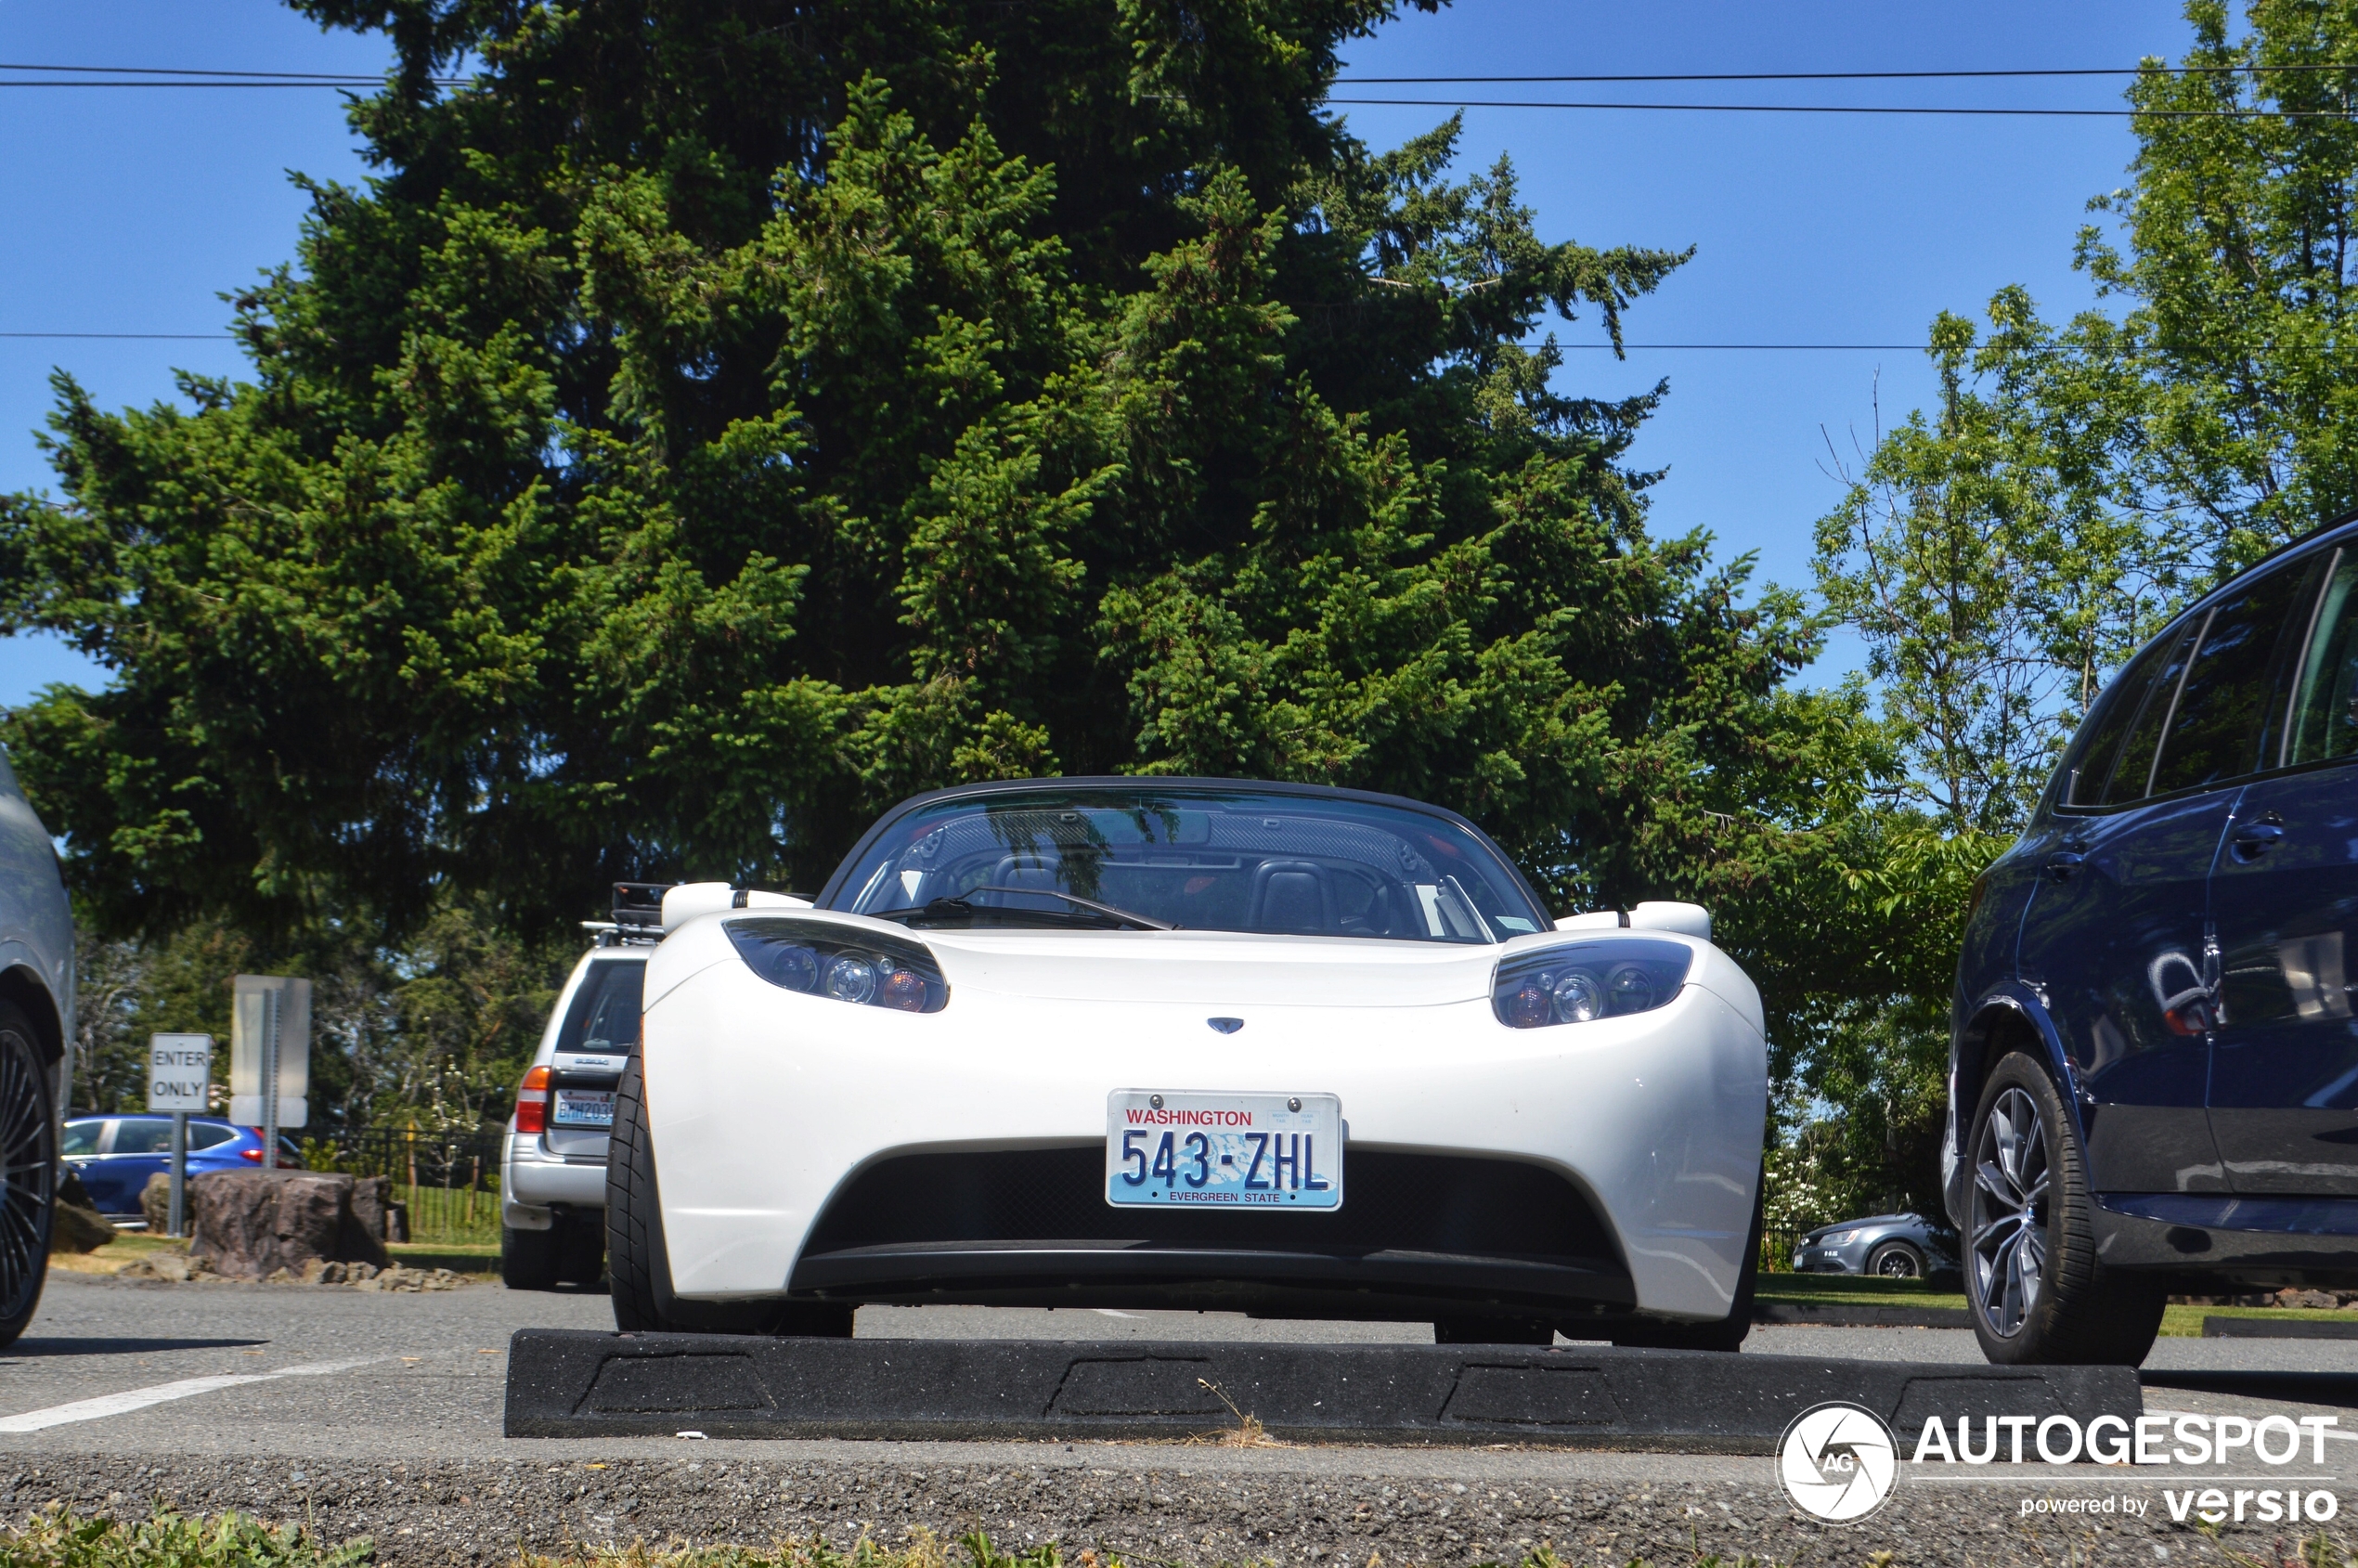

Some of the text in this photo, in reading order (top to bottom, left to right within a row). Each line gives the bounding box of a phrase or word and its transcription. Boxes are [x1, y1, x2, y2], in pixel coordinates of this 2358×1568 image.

[155, 1051, 206, 1066] ENTER
[154, 1082, 203, 1095] ONLY
[1126, 1109, 1251, 1125] WASHINGTON
[1121, 1129, 1328, 1190] 543-ZHL
[1170, 1191, 1280, 1202] EVERGREEN STATE
